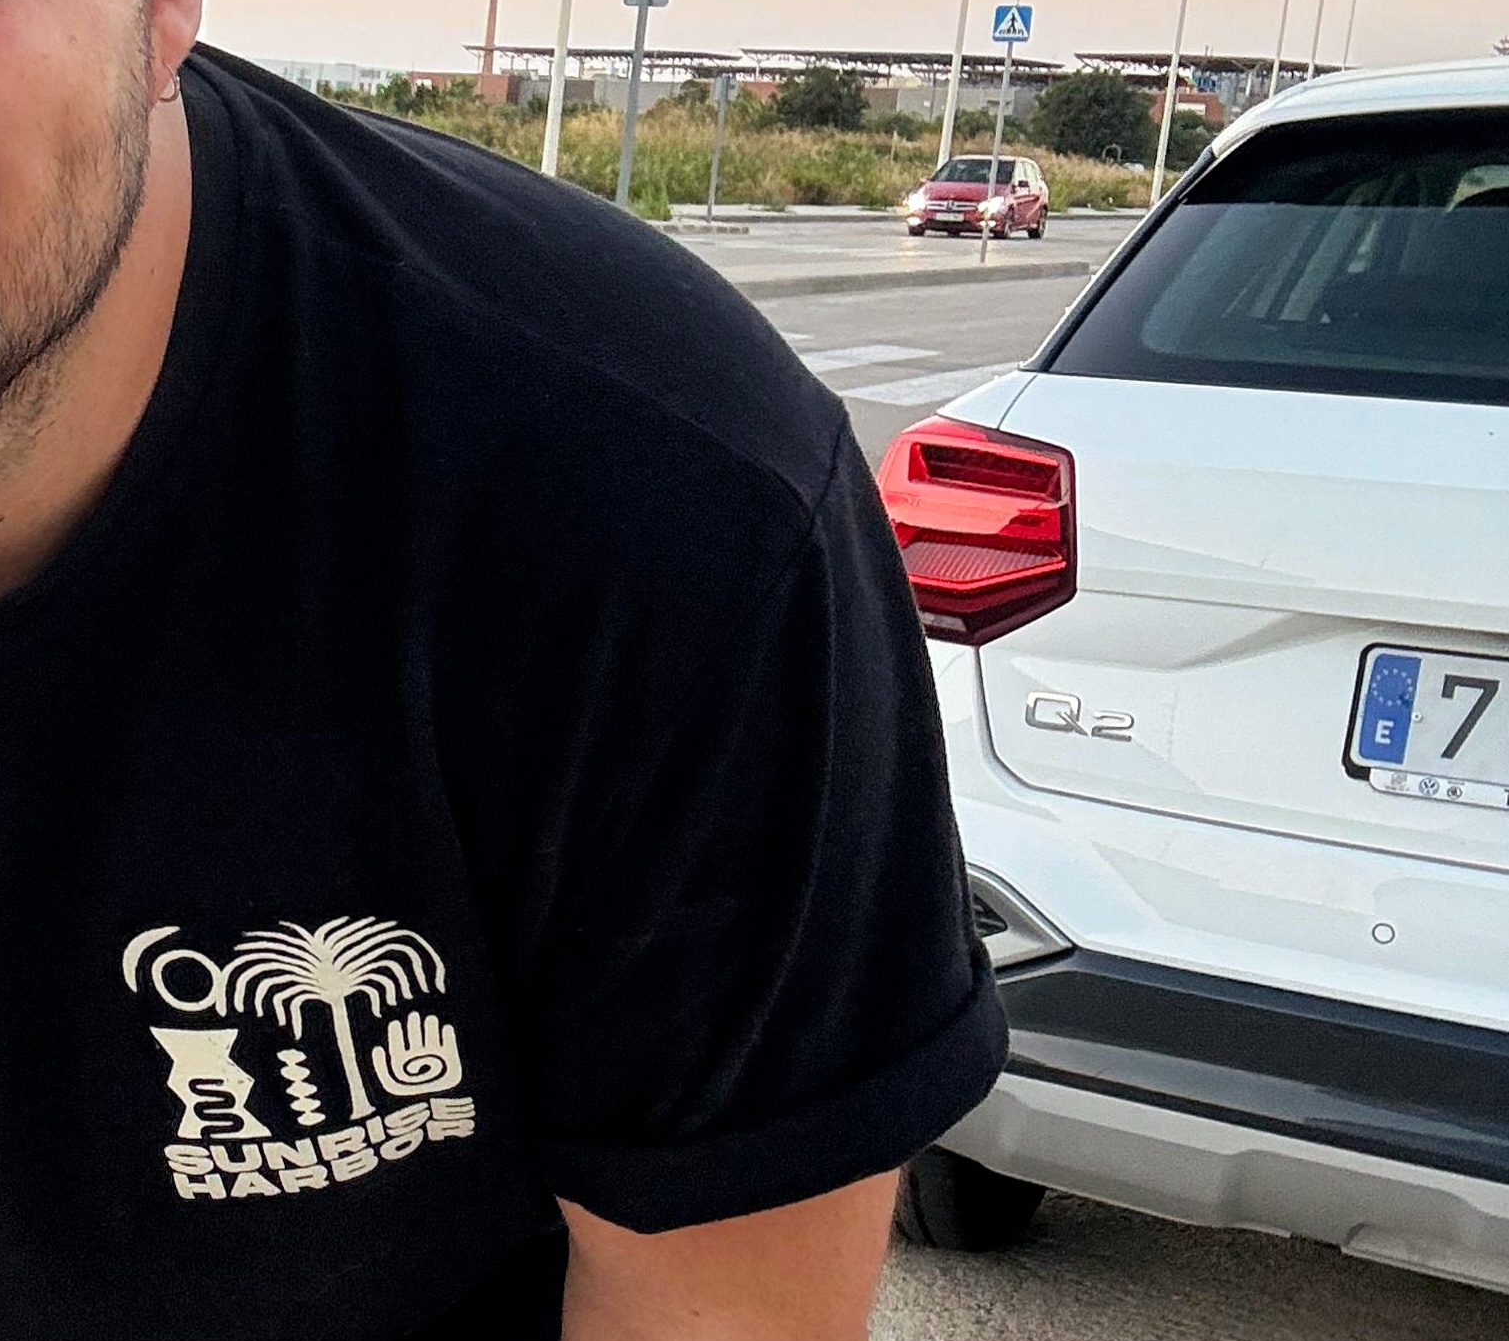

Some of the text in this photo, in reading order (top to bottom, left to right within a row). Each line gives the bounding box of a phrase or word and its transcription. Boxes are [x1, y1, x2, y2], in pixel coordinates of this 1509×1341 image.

[1024, 690, 1135, 742] Q2
[1374, 719, 1394, 745] E
[1440, 673, 1500, 760] 7
[163, 1096, 476, 1176] SUNRISE
[173, 1118, 476, 1200] HARBOR
